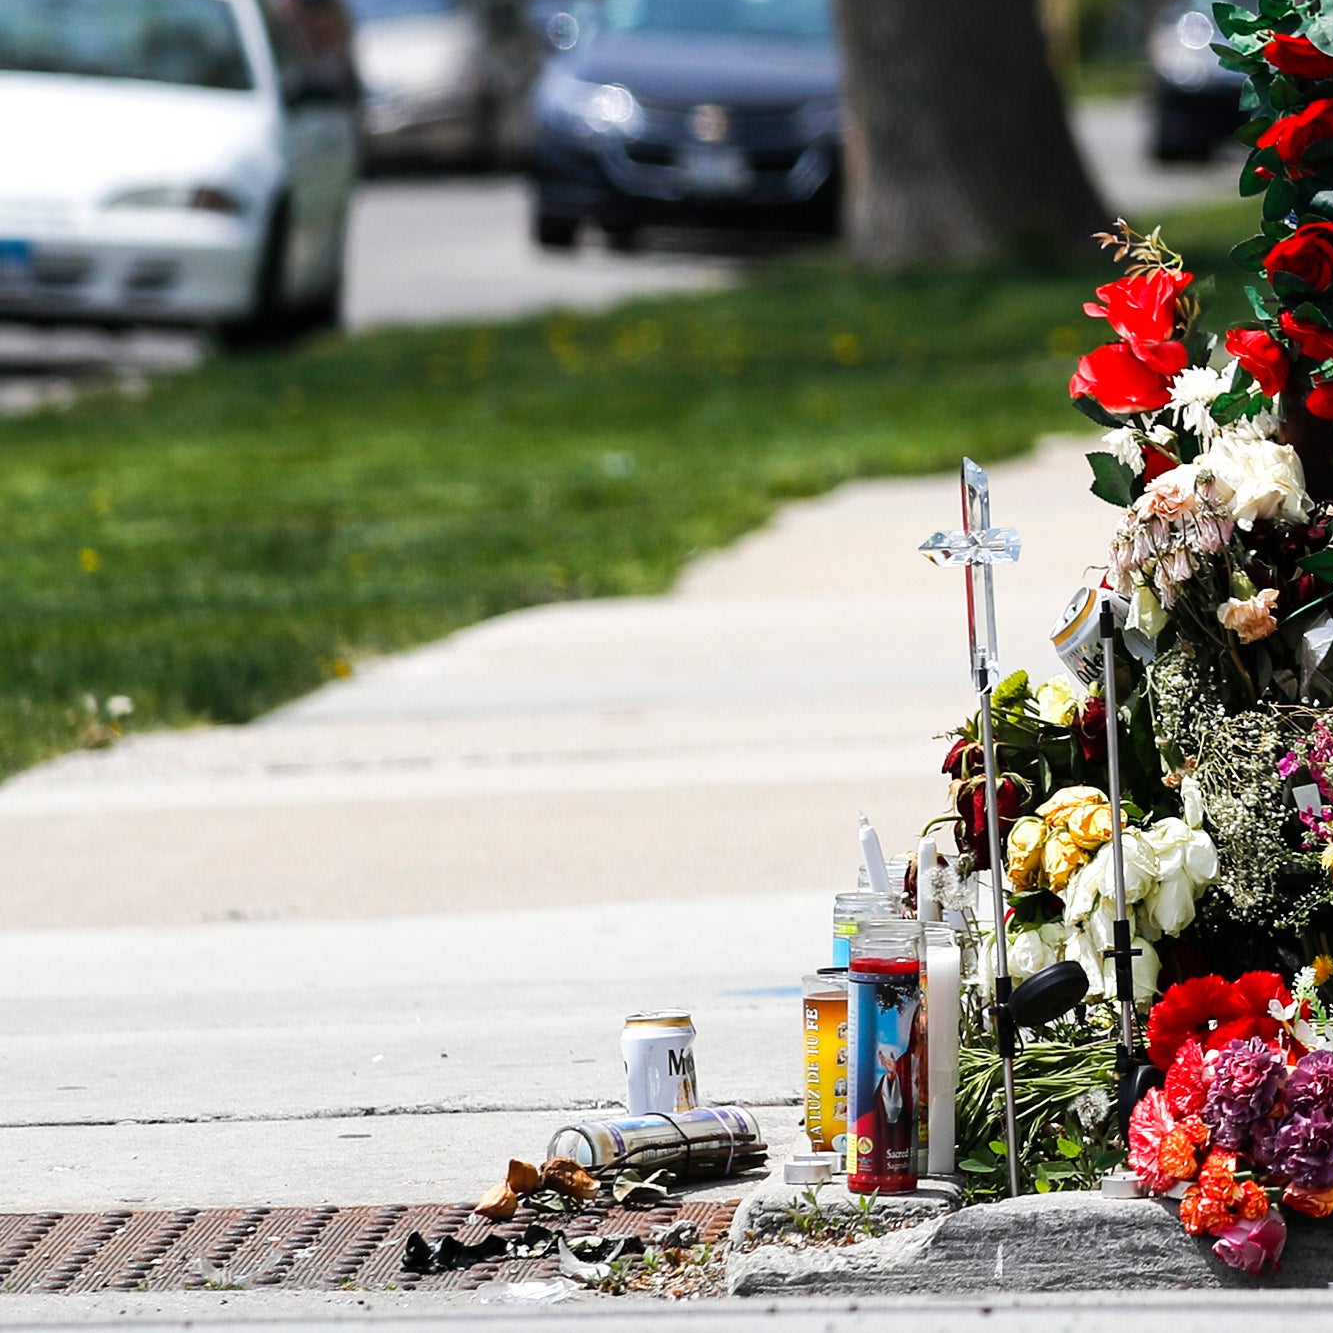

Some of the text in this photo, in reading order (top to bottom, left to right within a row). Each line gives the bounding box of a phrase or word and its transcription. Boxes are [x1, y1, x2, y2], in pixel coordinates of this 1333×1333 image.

[805, 1008, 825, 1145] LA LUZ DE TU FE
[886, 1148, 909, 1160] Sacred
